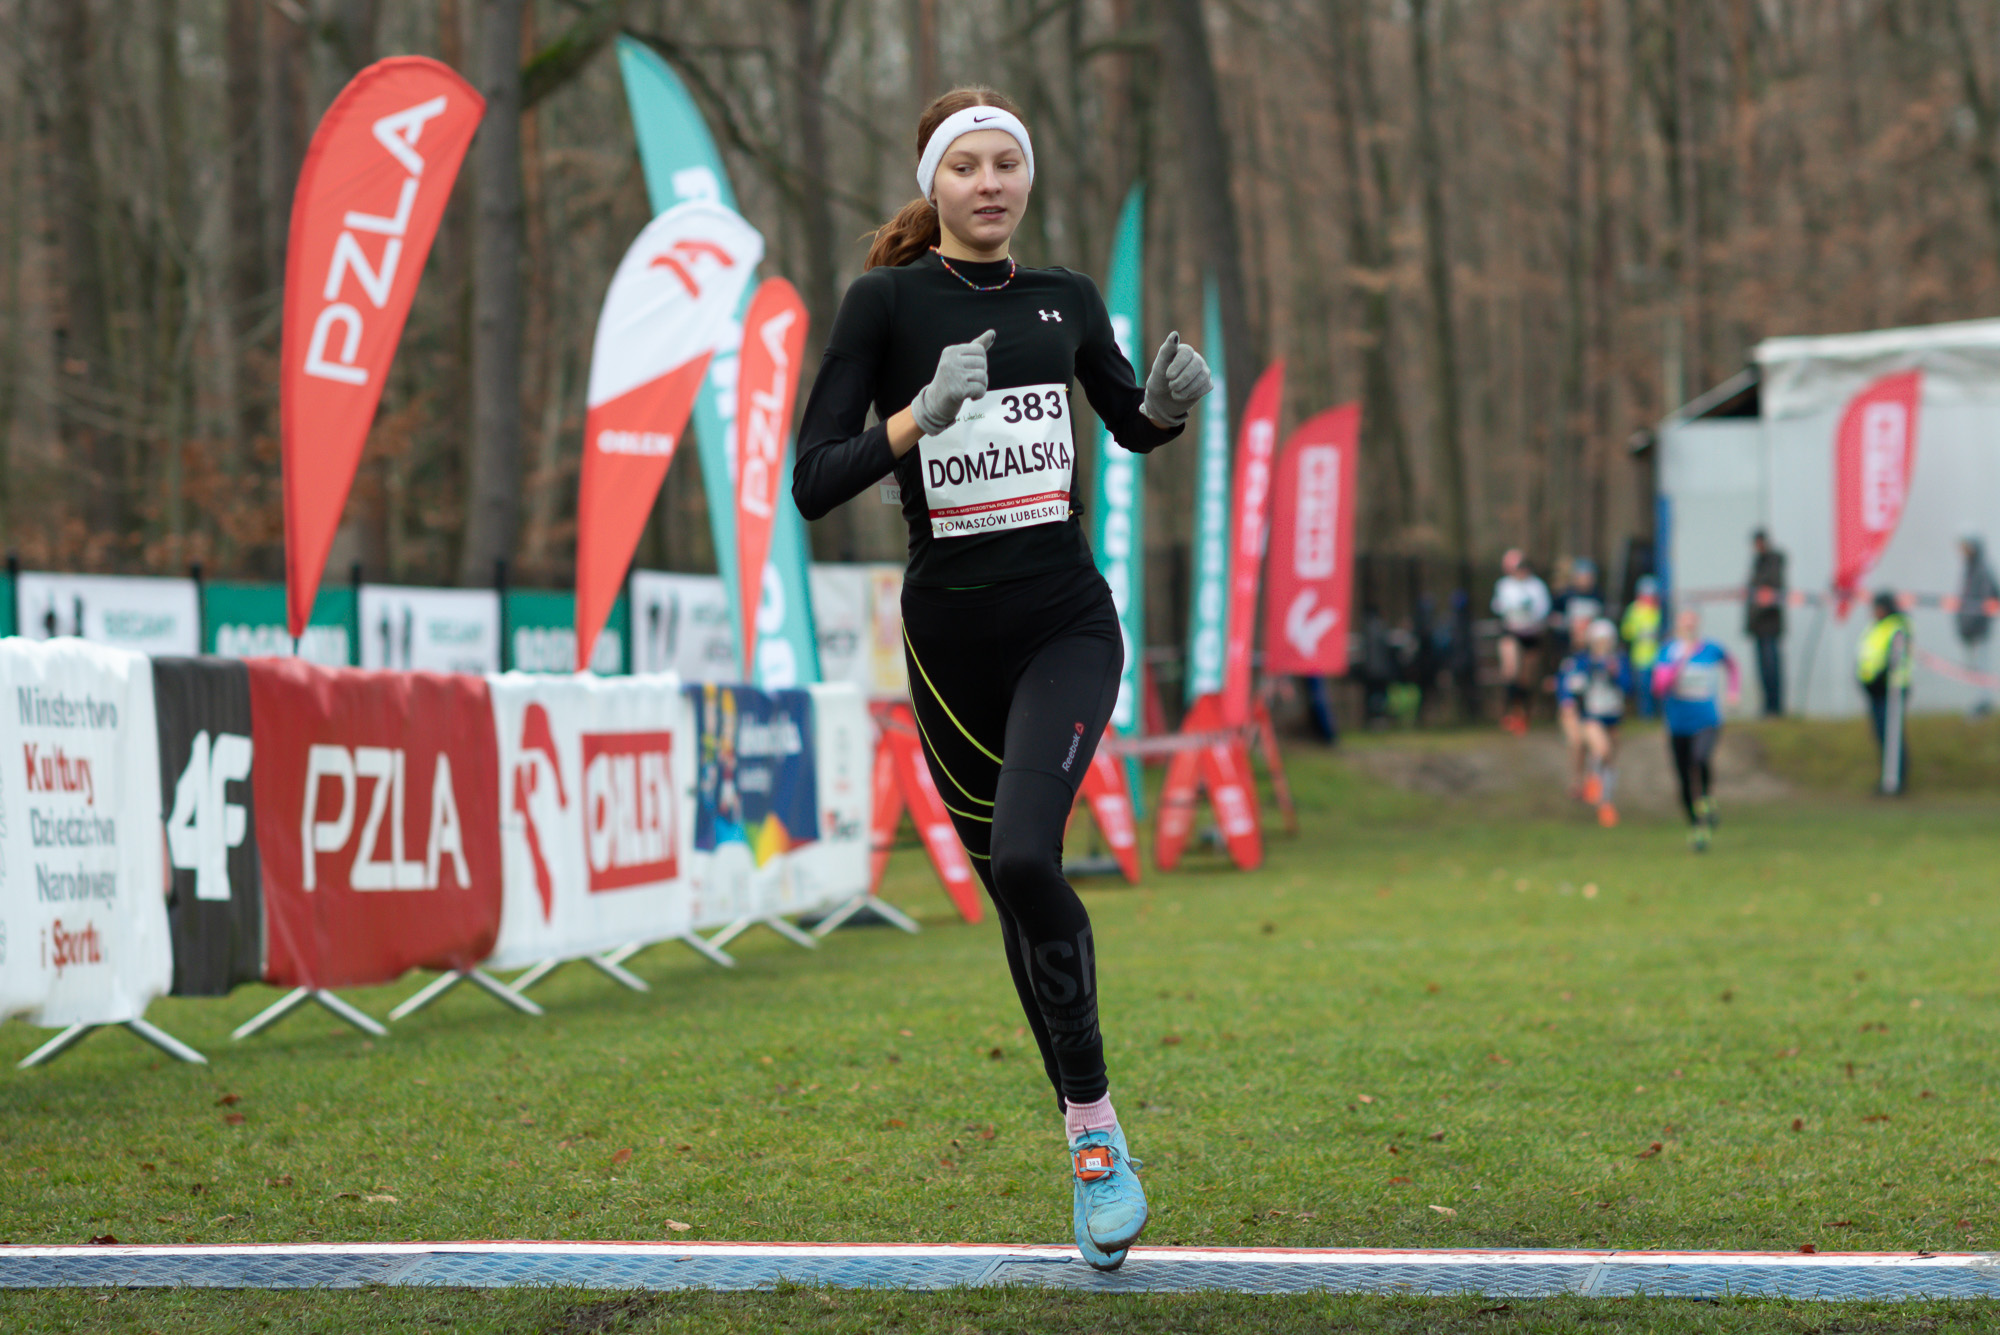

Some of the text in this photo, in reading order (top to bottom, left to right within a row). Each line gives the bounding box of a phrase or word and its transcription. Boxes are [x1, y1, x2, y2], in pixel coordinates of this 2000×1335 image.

[304, 95, 447, 386] PZLA
[741, 309, 796, 519] PZLA
[1001, 390, 1063, 423] 383
[928, 441, 1071, 489] DOMŻALSKA
[939, 514, 1007, 532] TOMASZÓW
[1011, 505, 1059, 522] LUBELSKI
[960, 503, 997, 513] MISTRZOSTWA
[996, 500, 1015, 508] POLSKI
[1021, 496, 1044, 504] BIEGACH
[24, 742, 94, 806] Kultury
[1062, 732, 1081, 772] Reebok
[167, 730, 253, 900] 4F
[302, 744, 471, 892] PZLA
